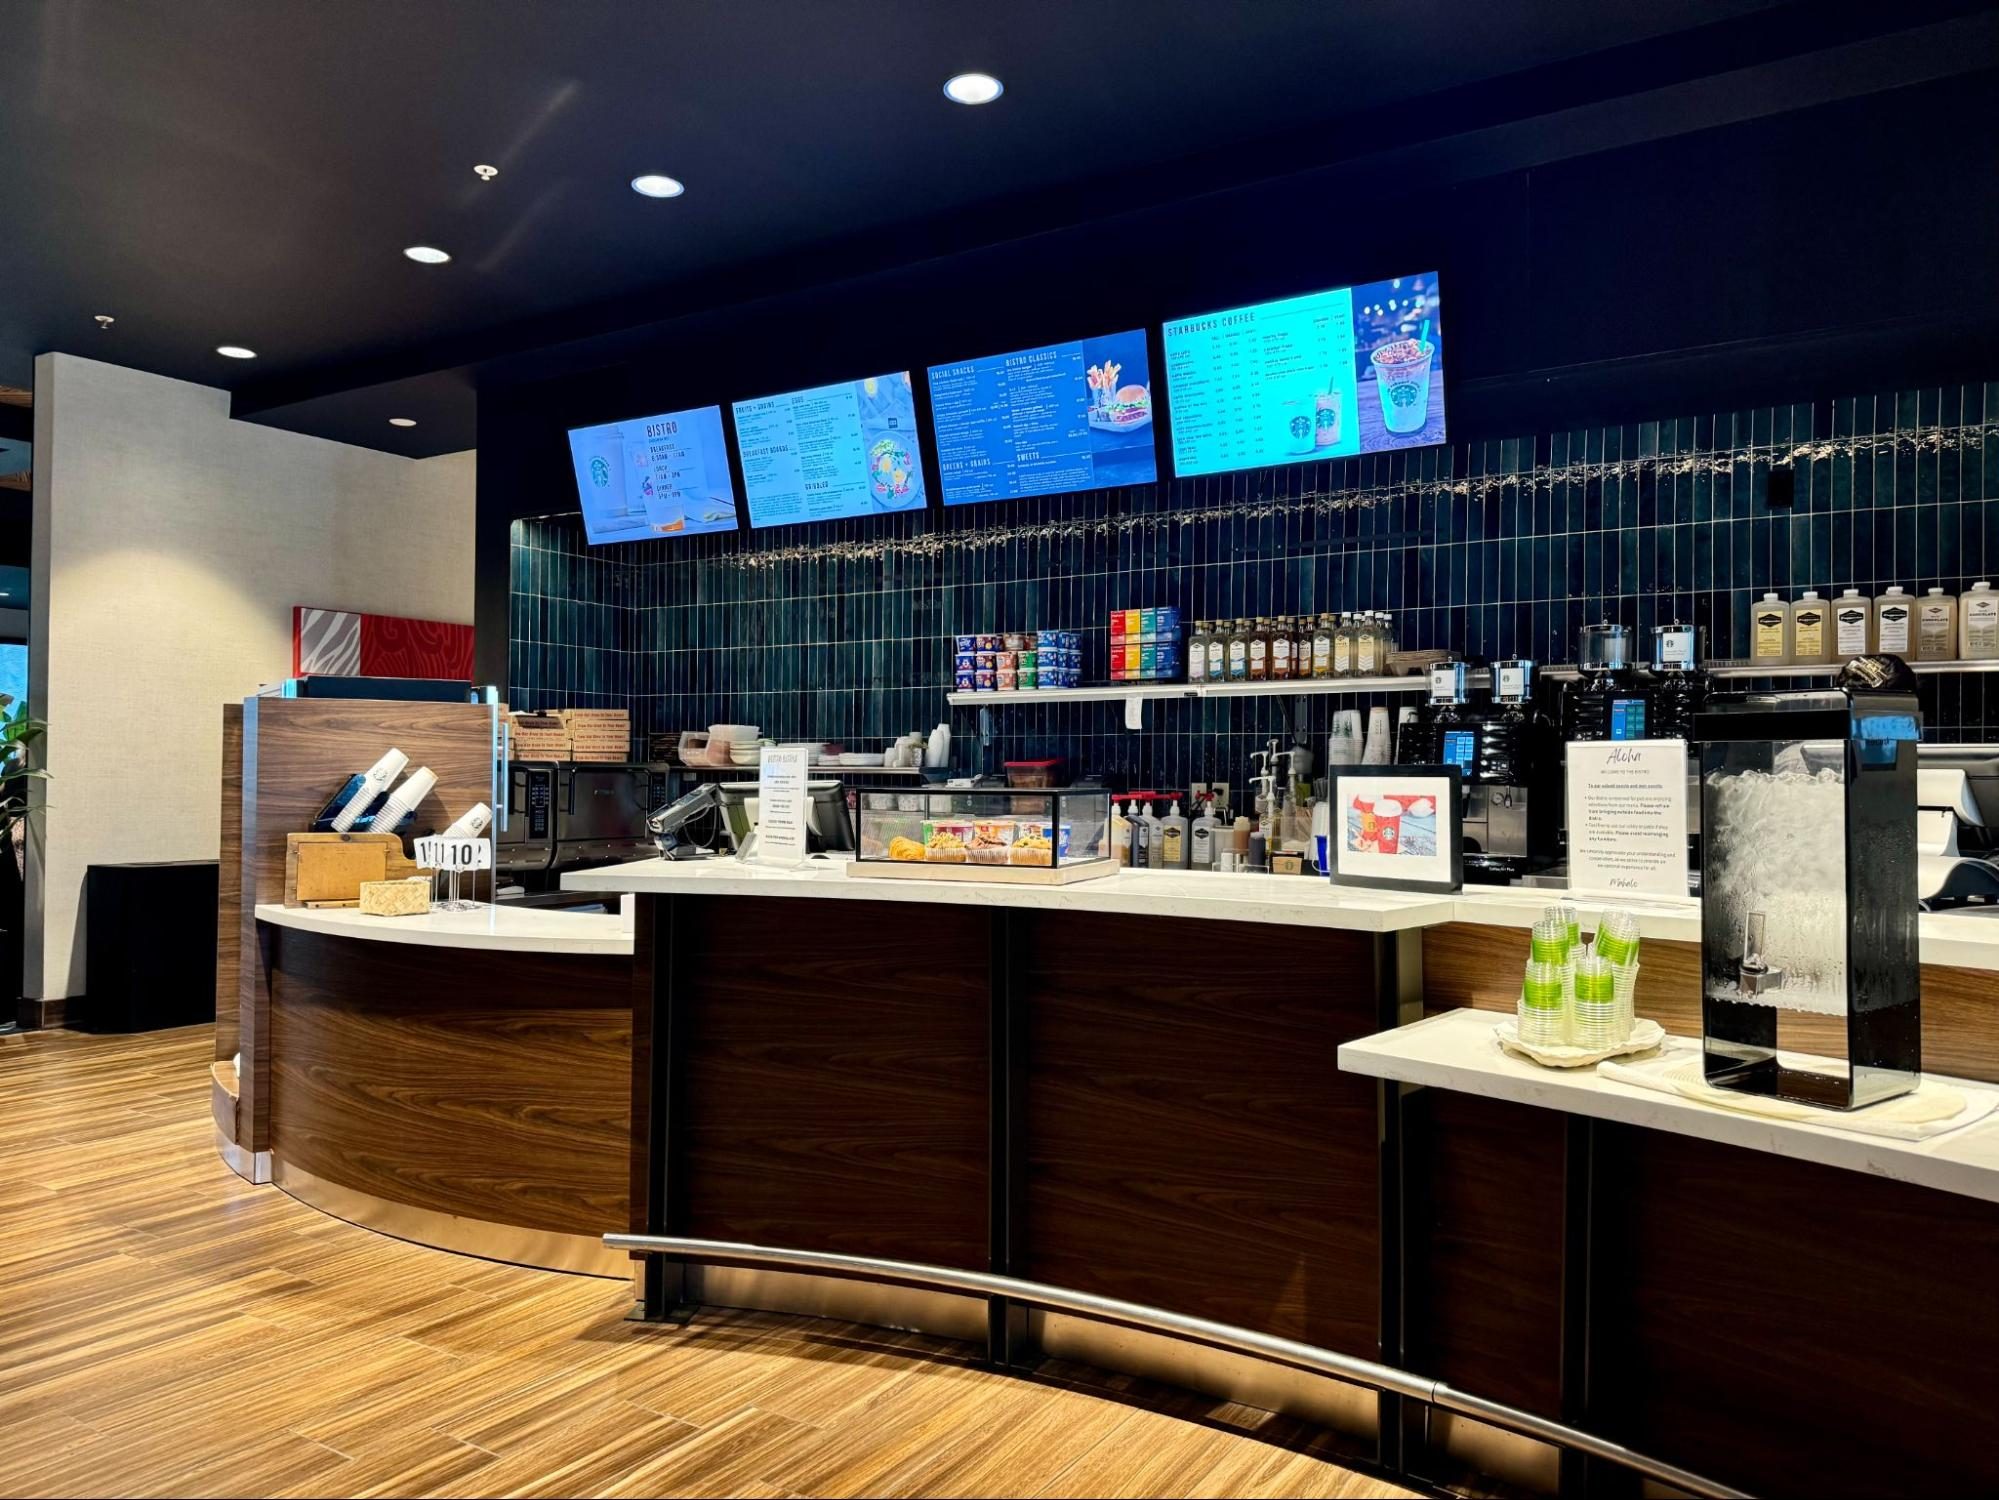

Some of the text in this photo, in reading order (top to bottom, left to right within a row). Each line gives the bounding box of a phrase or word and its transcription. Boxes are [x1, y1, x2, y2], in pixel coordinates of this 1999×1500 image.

[1168, 312, 1255, 337] STARBUCKS COFFEE
[1005, 351, 1057, 366] BISTRO CLASSICS
[932, 366, 974, 380] SOCIAL SNACKS
[647, 421, 678, 437] BISTRO
[1017, 452, 1039, 461] SWEETS
[1606, 748, 1641, 764] Aloha
[451, 844, 472, 865] 10
[1609, 878, 1638, 888] Mahalo
